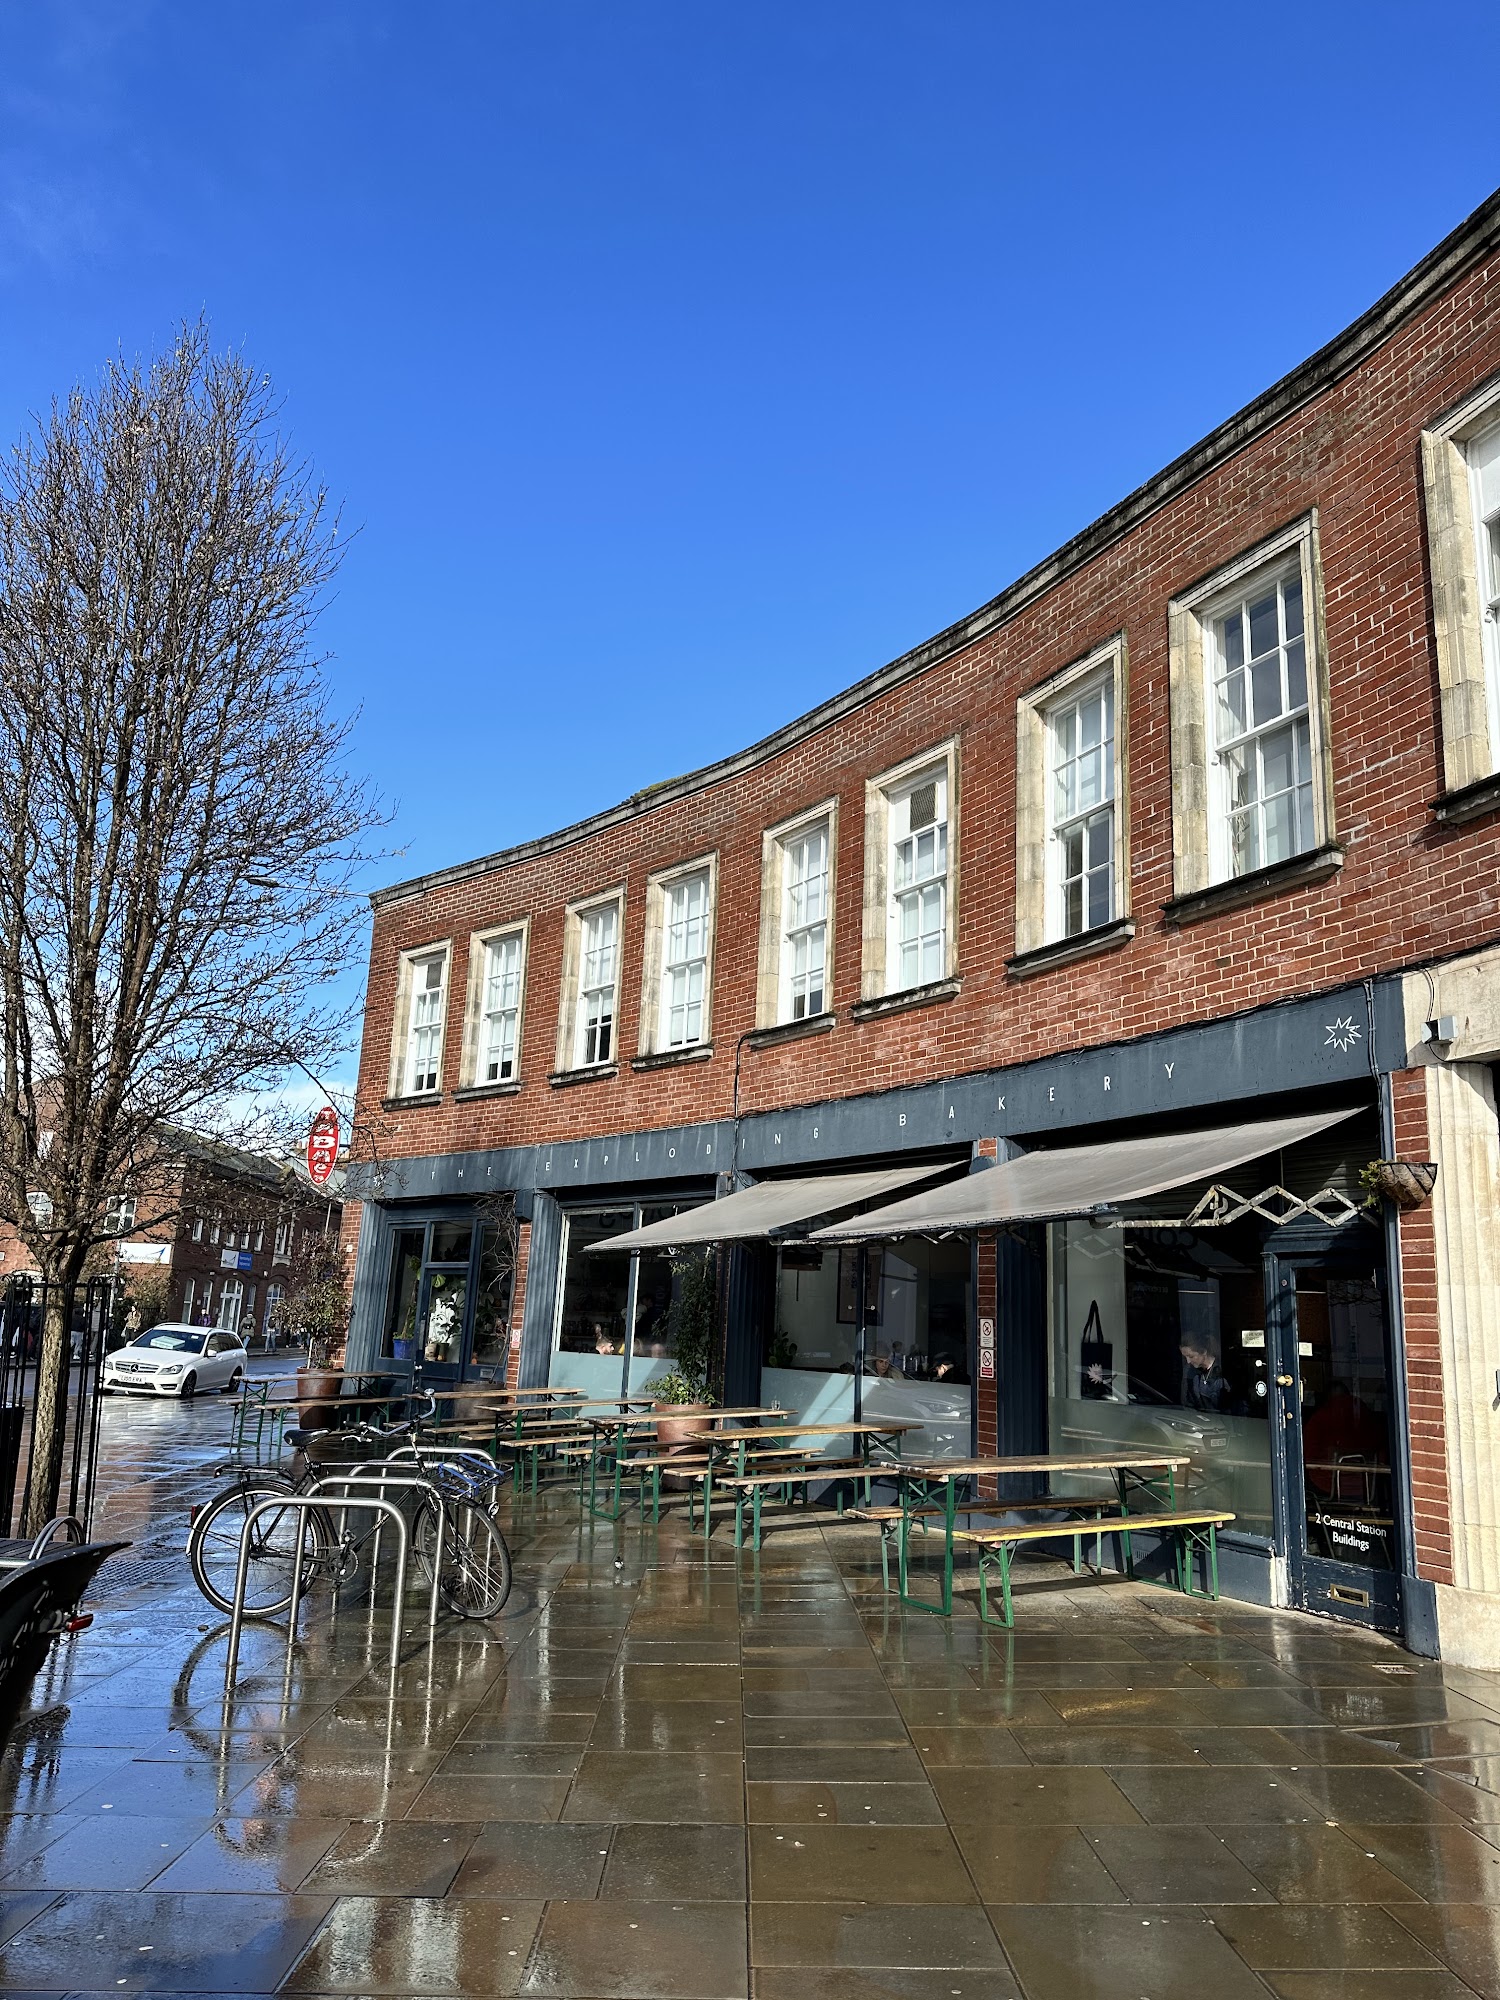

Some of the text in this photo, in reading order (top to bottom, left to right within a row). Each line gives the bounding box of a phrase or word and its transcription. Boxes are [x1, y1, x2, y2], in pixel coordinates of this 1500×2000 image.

[431, 1062, 1175, 1180] THE EXPLODING BAKERY
[1315, 1513, 1387, 1538] 2 Central Station
[1332, 1531, 1370, 1552] Buildings
